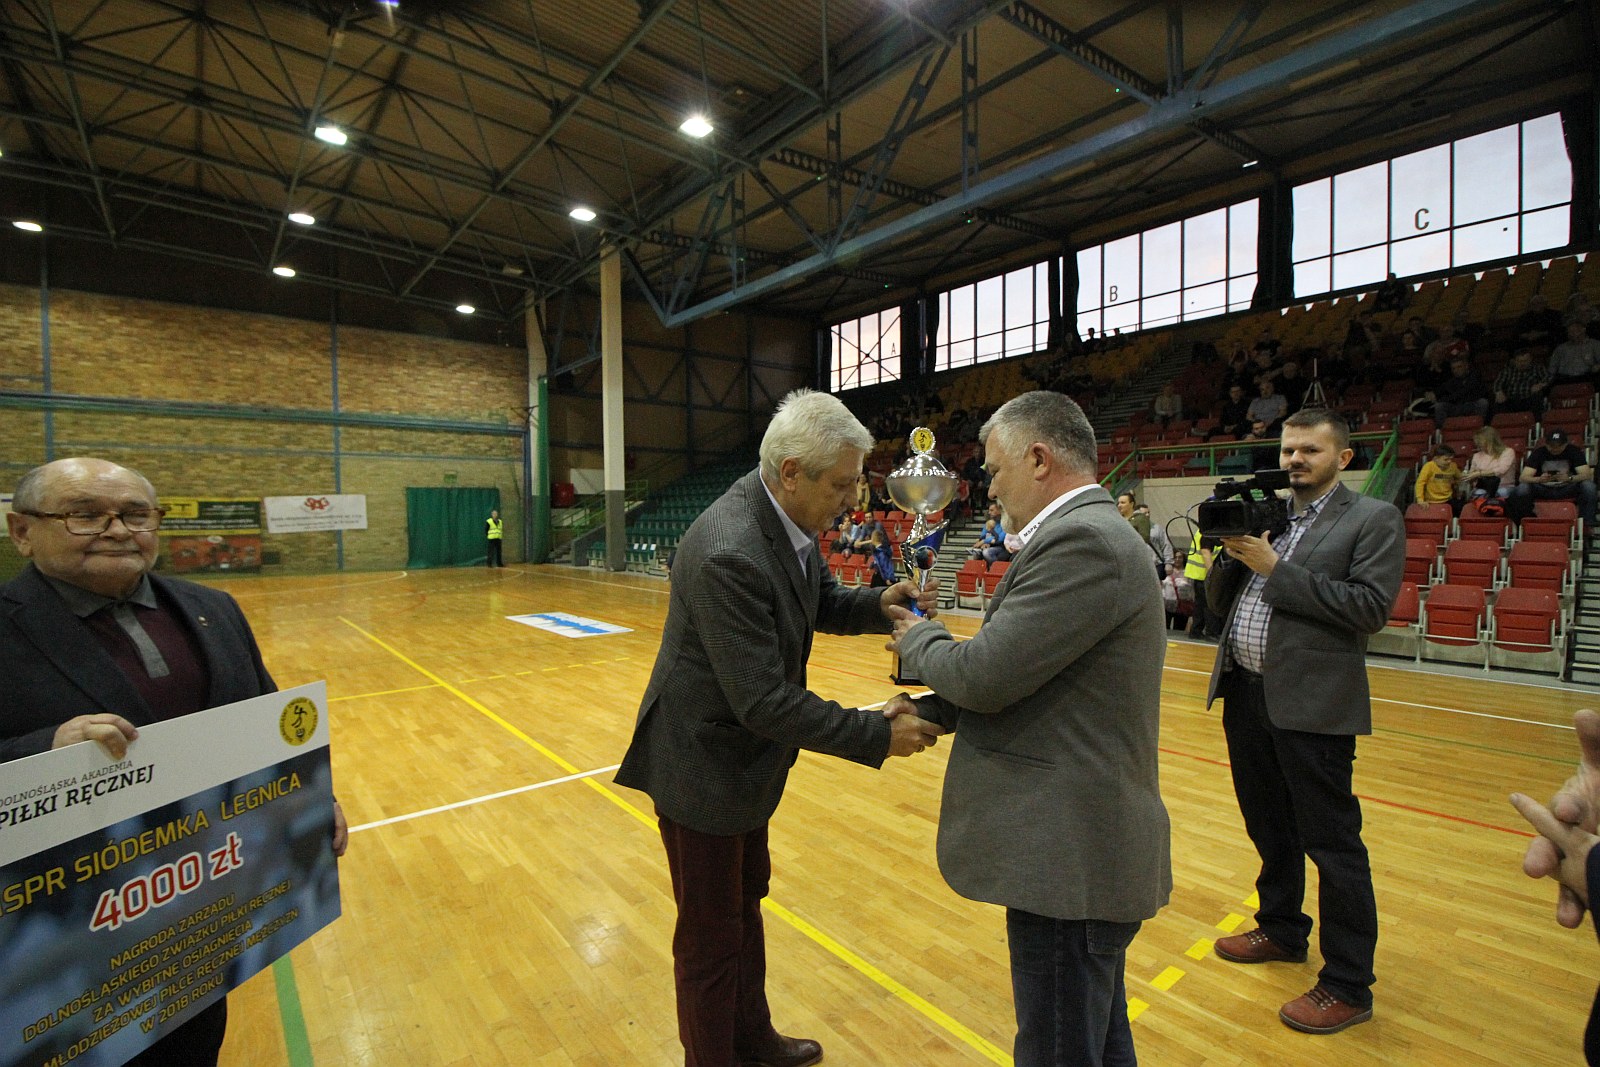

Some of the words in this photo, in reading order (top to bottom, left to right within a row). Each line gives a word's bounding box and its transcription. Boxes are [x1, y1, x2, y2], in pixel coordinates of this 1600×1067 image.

[1415, 208, 1430, 230] C
[1110, 285, 1118, 302] B
[890, 342, 896, 355] A
[1562, 399, 1577, 408] VIP
[0, 795, 58, 829] PIŁKI
[65, 764, 155, 805] RĘCZNEJ
[80, 760, 133, 782] AKADEMIA
[0, 867, 66, 917] SPR
[74, 810, 208, 882] SIÓDEMKA
[220, 772, 301, 821] LEGNICA
[91, 853, 202, 930] 4000
[210, 834, 242, 880] zł
[24, 954, 159, 1042] DOLNOŚLĄSKIEGO
[162, 920, 220, 961] ZWIĄZKU
[220, 905, 249, 927] PIŁKI
[249, 880, 291, 910] RĘCZNEJ
[110, 925, 176, 970] NAGRODA
[179, 892, 236, 932] ZARZĄDU
[43, 995, 157, 1067] MŁODZIEŻOWEJ
[160, 973, 194, 1001] PIŁCE
[196, 941, 244, 978] RĘCZNEJ
[94, 1002, 114, 1023] ZA
[118, 961, 180, 1006] WYBITNE
[182, 920, 252, 968] OSIĄGNIĘCIA
[140, 1015, 155, 1033] W
[159, 994, 189, 1023] 2018
[191, 973, 225, 1002] ROKU
